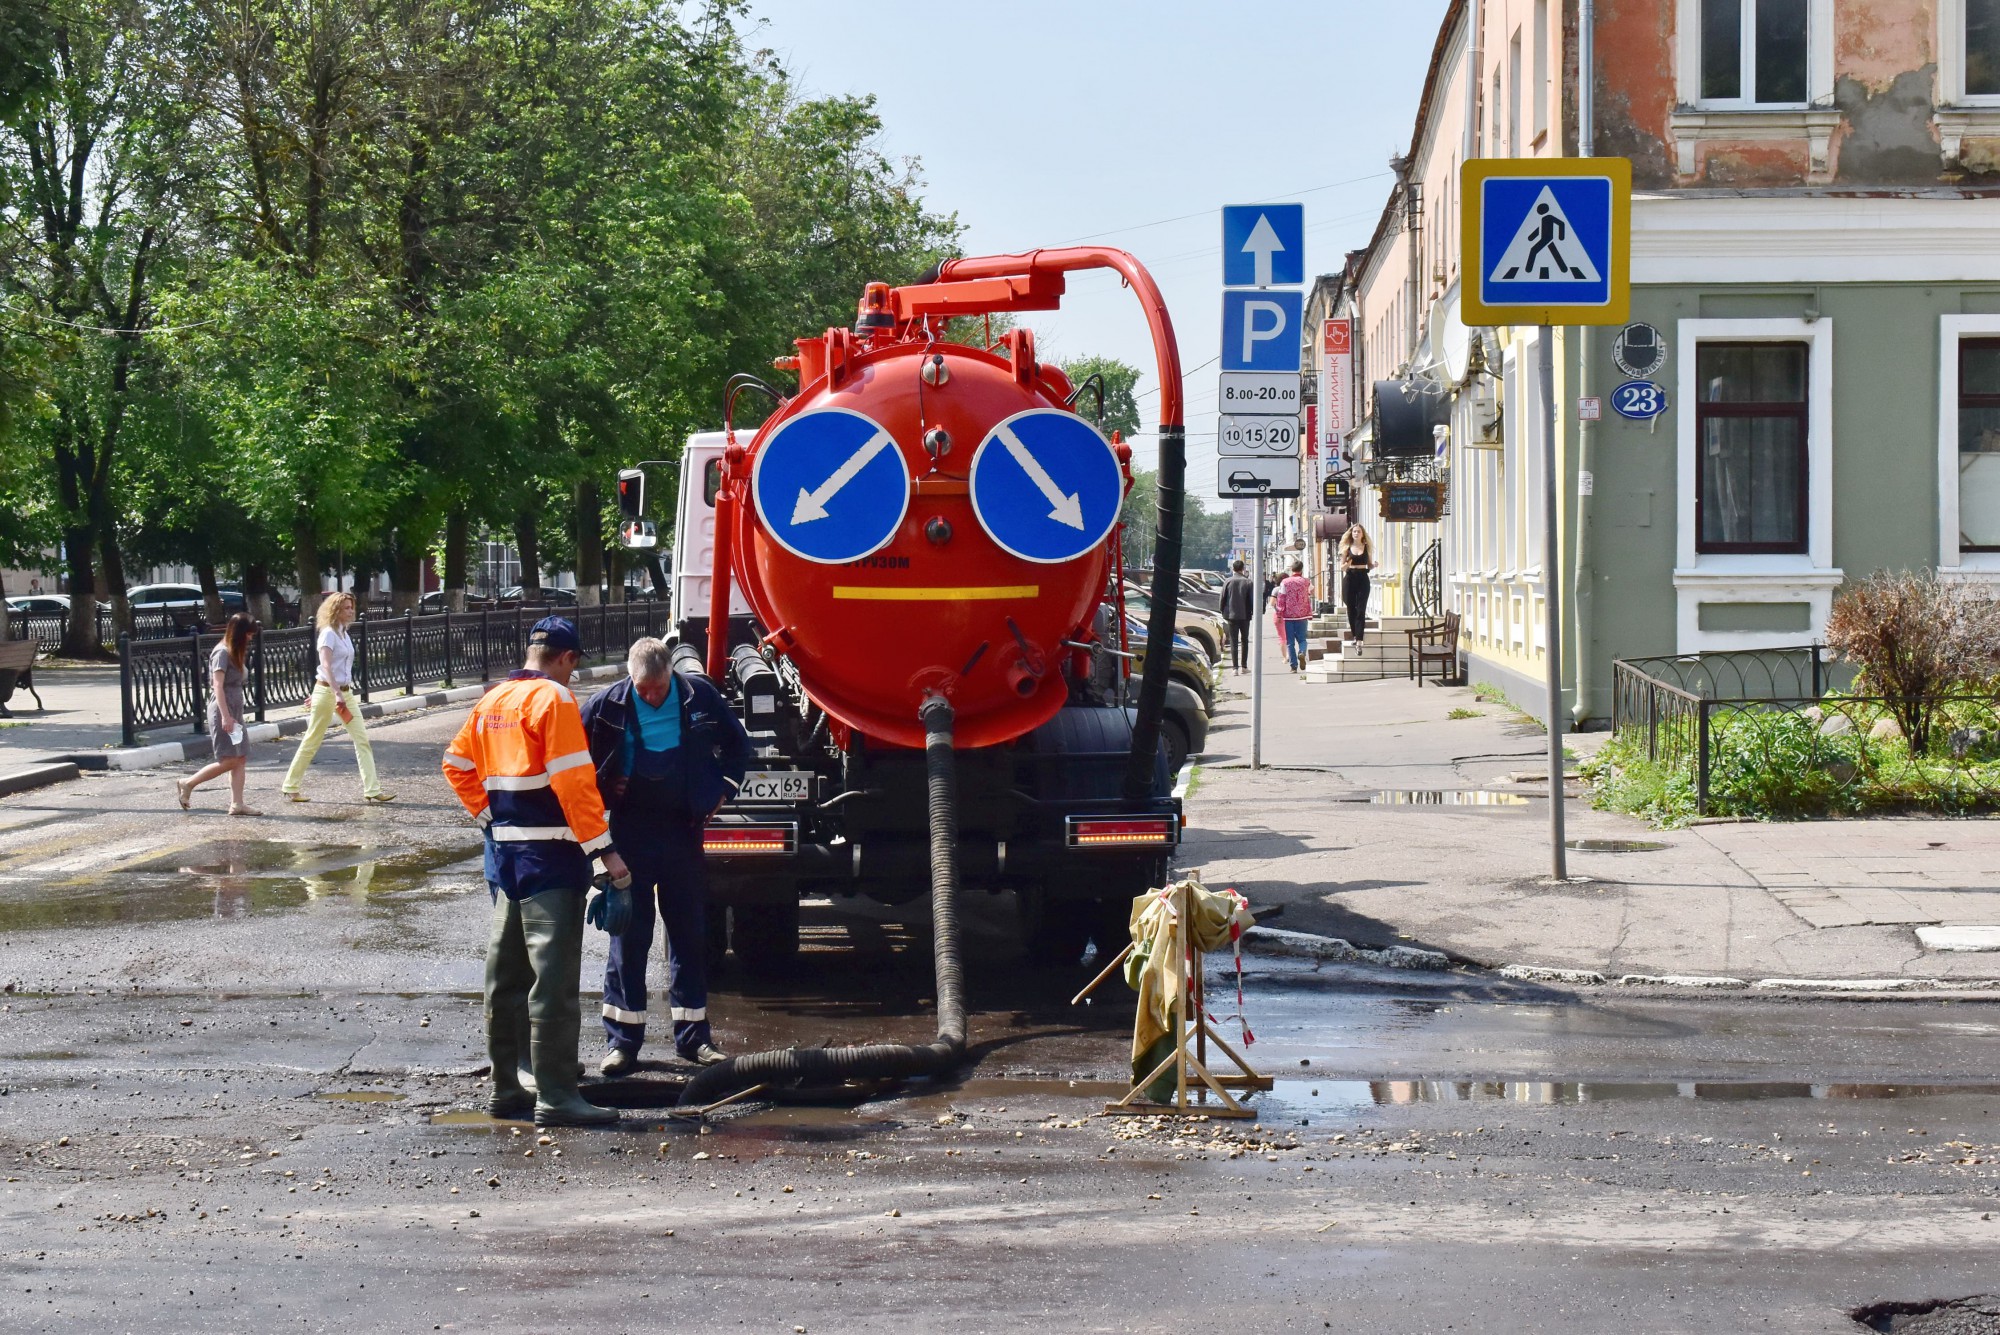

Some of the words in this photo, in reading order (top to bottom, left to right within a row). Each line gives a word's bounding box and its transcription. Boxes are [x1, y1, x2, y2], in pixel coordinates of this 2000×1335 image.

[1242, 300, 1287, 363] P
[1226, 387, 1296, 400] 8.00-20.00
[1330, 356, 1340, 430] СИТИЛИНК
[1622, 387, 1658, 413] 23
[1225, 430, 1241, 441] 10
[1245, 429, 1263, 442] 15
[1269, 428, 1291, 443] 20
[737, 779, 778, 798] 4СХ
[783, 778, 802, 792] 69
